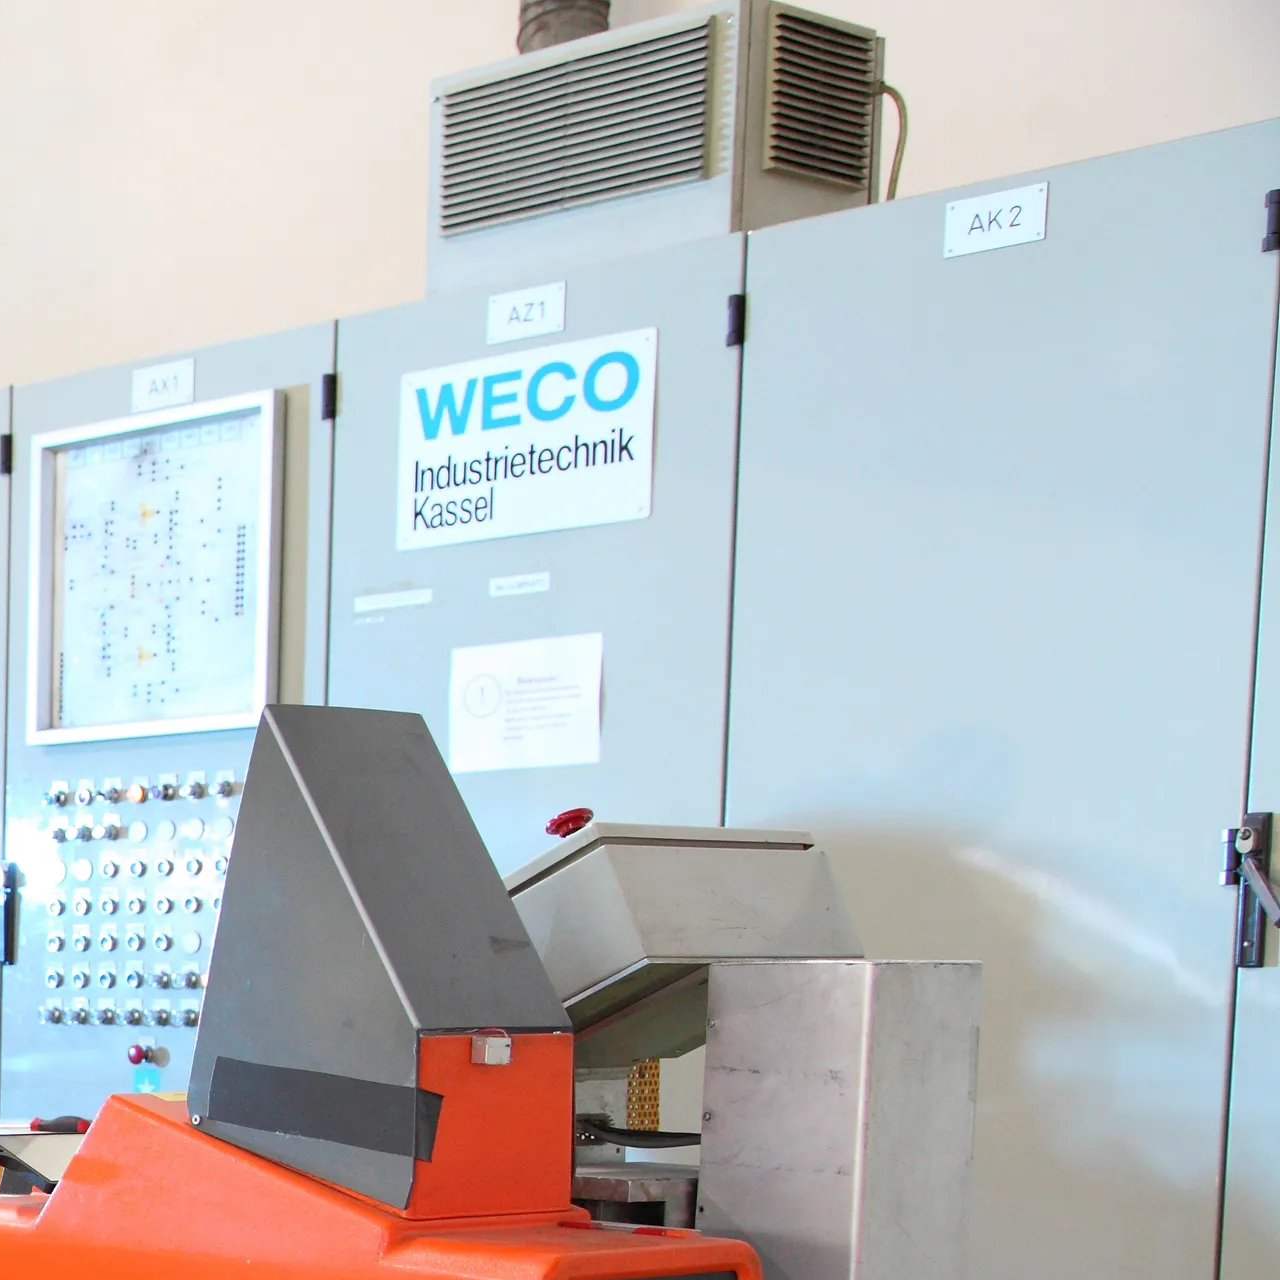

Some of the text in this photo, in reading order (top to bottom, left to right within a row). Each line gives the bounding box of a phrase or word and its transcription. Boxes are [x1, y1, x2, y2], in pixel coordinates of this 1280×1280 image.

[507, 301, 546, 325] AZ1
[148, 375, 179, 396] AX1
[415, 350, 640, 441] WECO
[413, 427, 635, 493] Industrietechnik
[413, 486, 494, 531] Kassel
